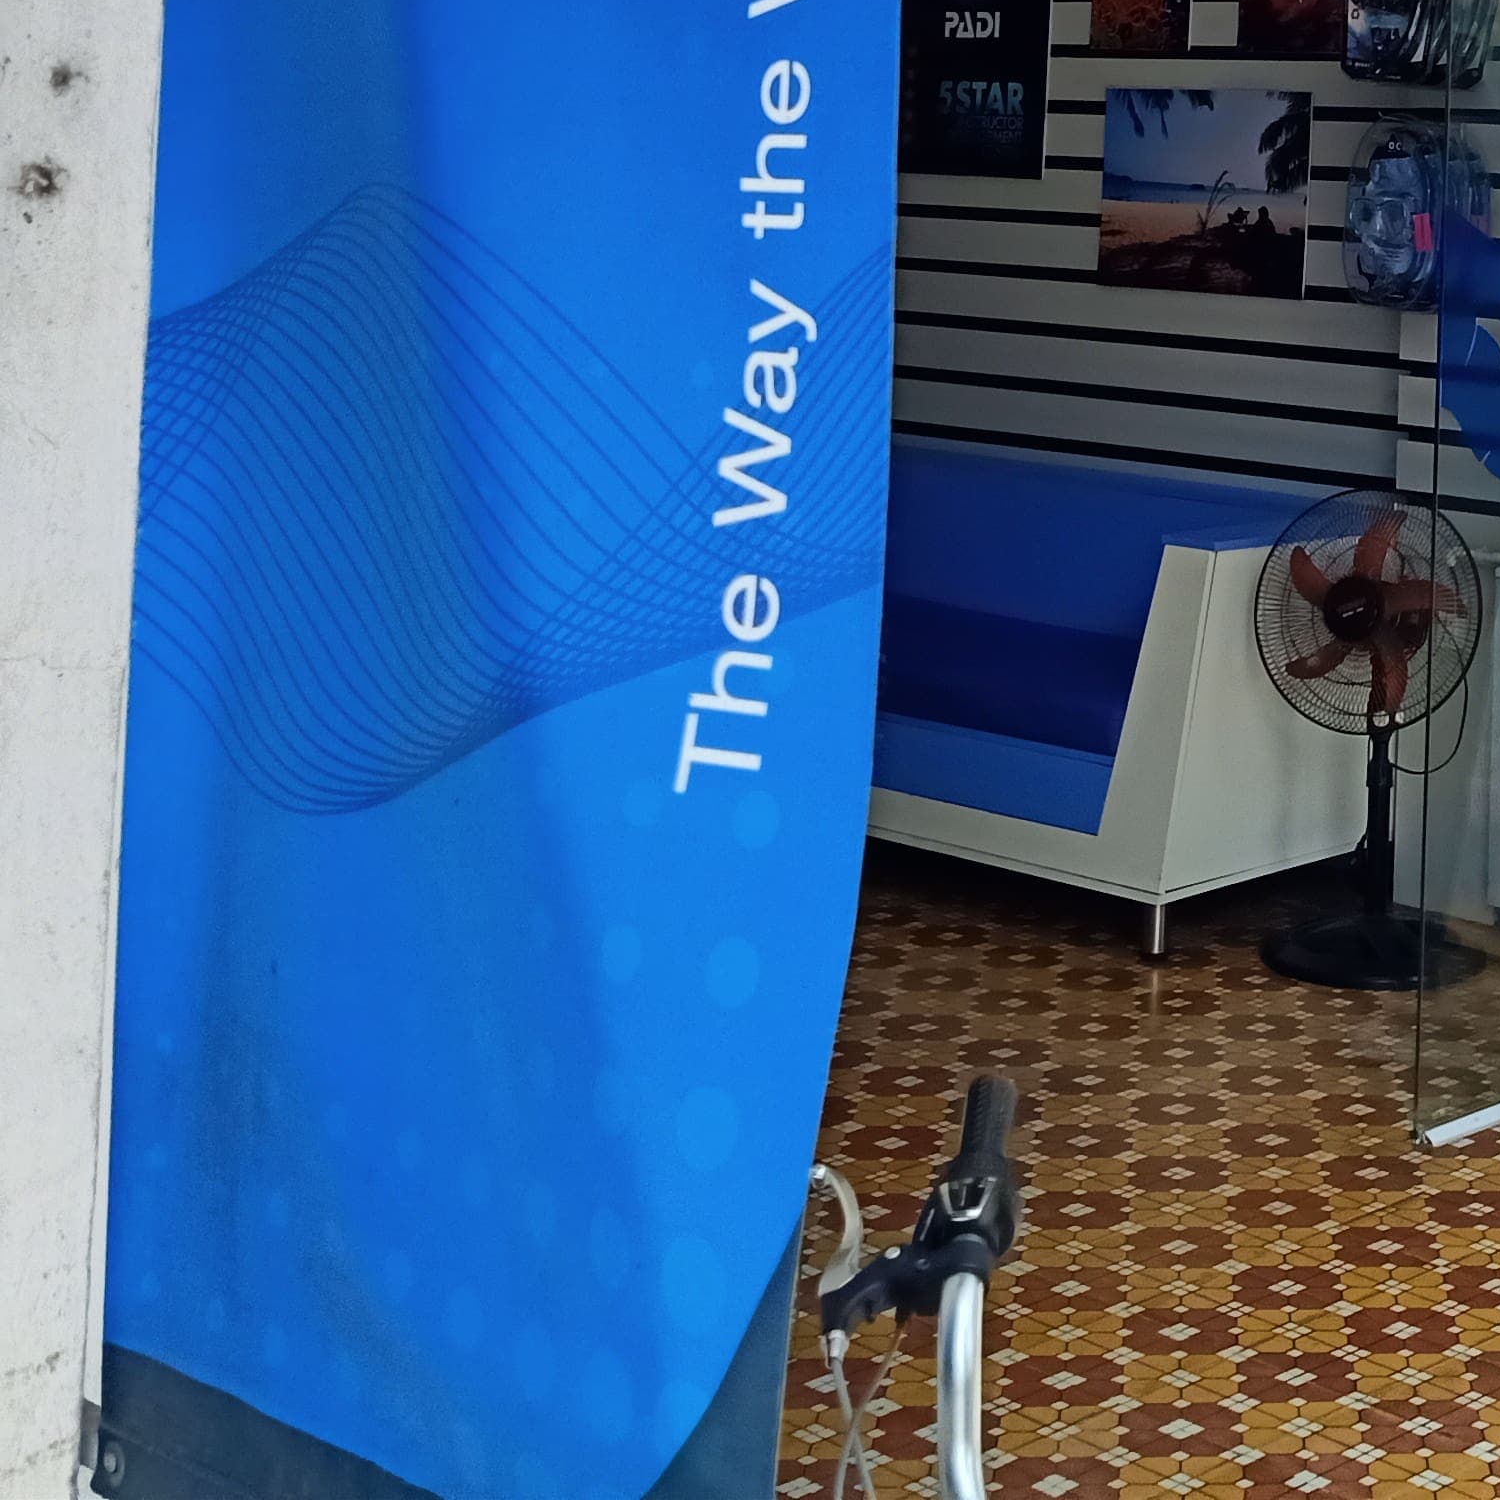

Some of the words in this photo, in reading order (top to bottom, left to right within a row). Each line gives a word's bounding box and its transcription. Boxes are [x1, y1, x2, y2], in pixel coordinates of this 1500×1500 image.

[944, 11, 1001, 38] PADI
[740, 59, 812, 240] the
[712, 278, 818, 527] Way
[674, 574, 782, 794] The
